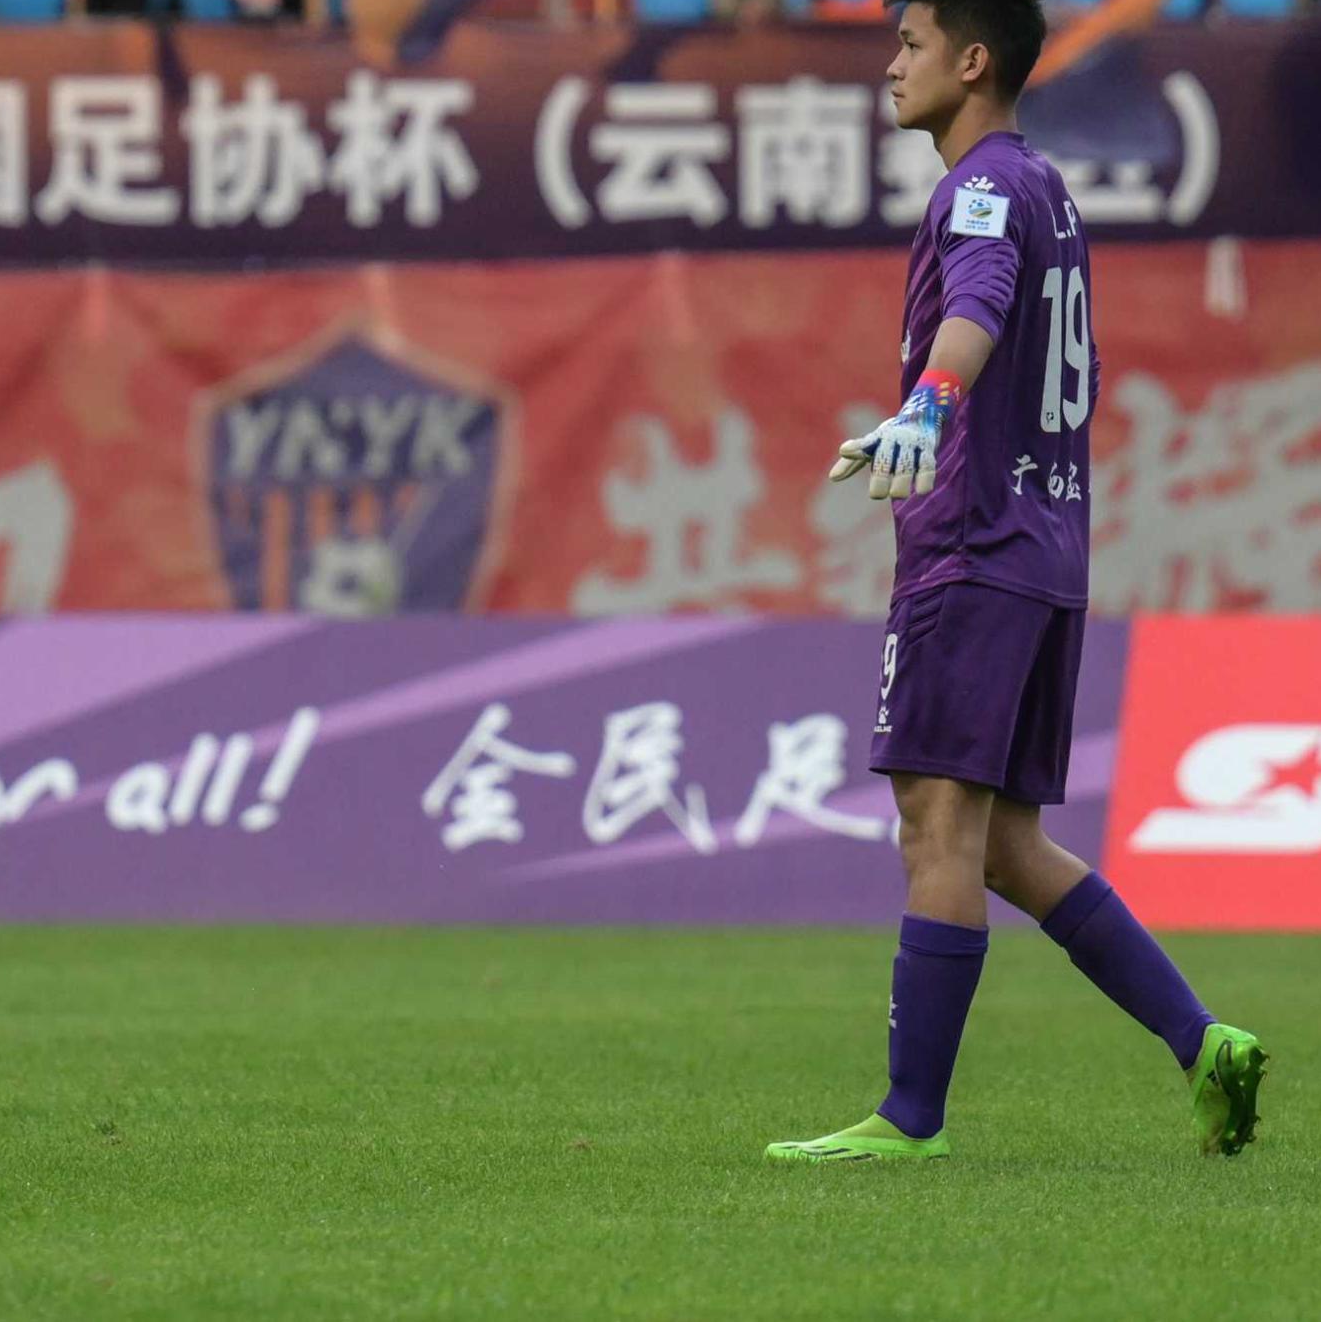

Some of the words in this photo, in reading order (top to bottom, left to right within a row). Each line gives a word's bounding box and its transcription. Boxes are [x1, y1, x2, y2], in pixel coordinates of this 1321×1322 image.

[1040, 265, 1090, 432] 19
[105, 706, 321, 832] all!
[422, 700, 902, 856] 全民足
